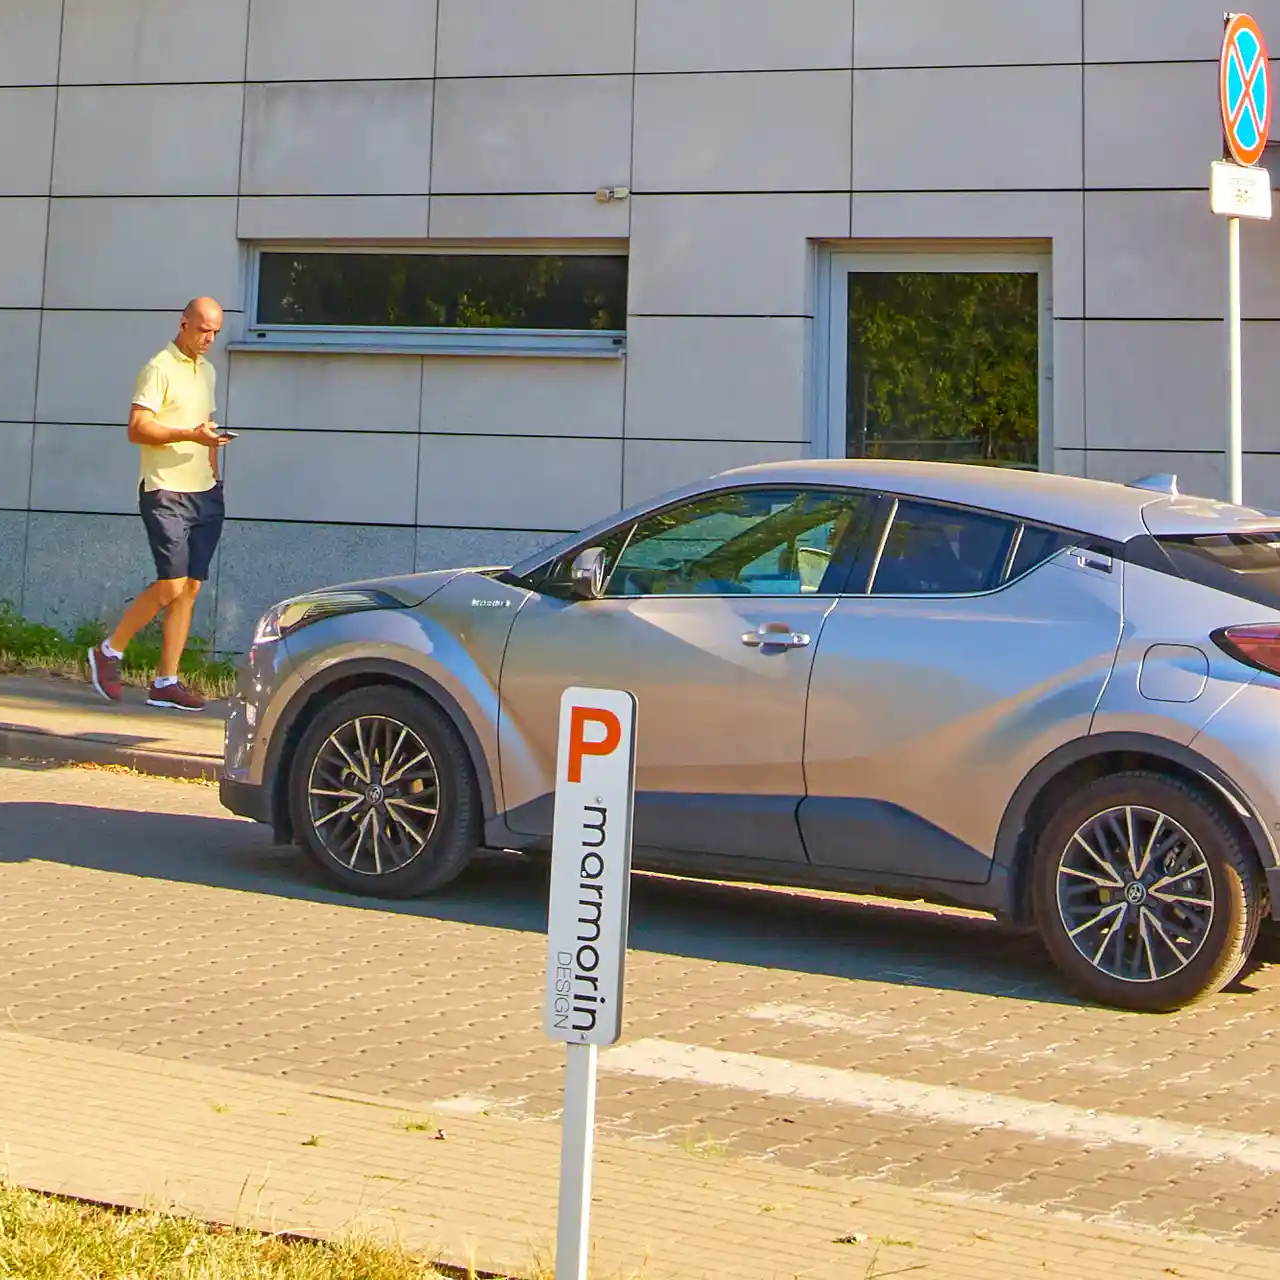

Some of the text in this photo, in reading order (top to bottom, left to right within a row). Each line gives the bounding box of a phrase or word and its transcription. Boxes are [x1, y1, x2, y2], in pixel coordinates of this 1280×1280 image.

[567, 705, 621, 783] P
[571, 804, 609, 1032] marmorin
[553, 951, 573, 1030] DESIGN
